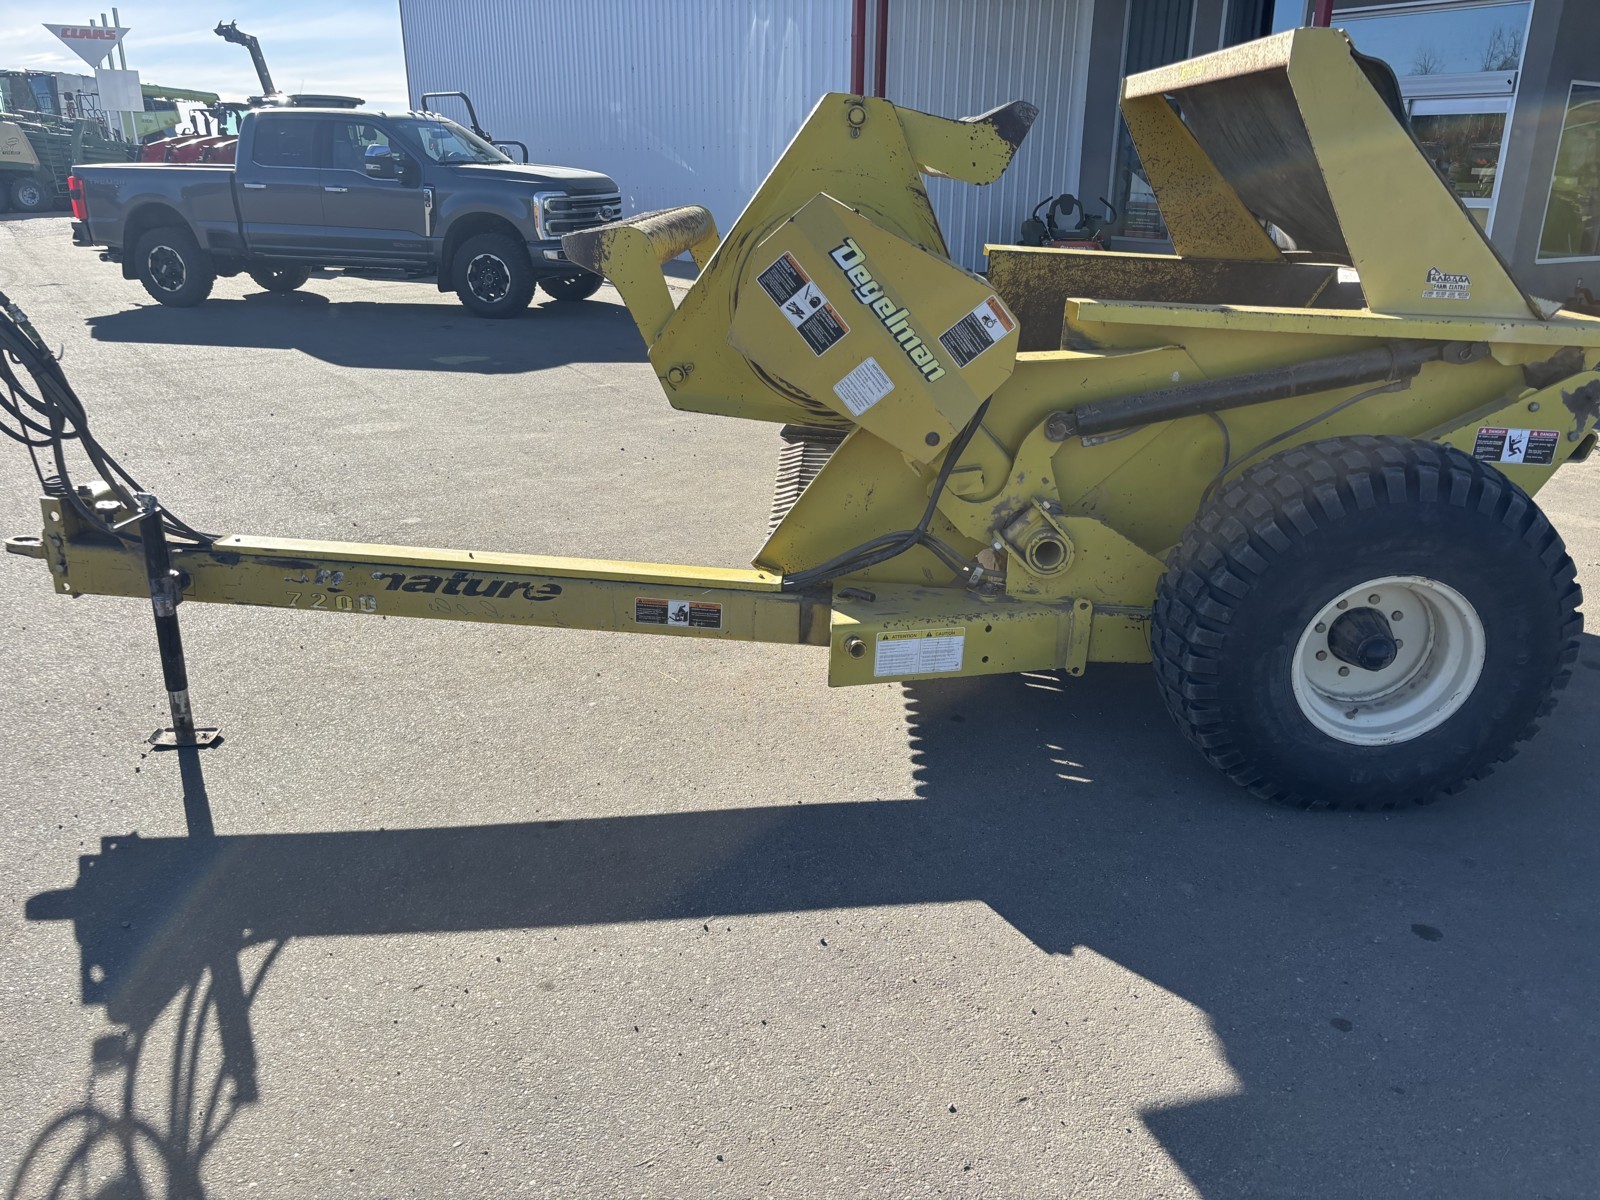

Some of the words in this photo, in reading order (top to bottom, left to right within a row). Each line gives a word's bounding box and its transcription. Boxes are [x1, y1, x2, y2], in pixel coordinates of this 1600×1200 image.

[61, 27, 116, 40] CLAAS
[1426, 267, 1470, 284] Pentagon
[828, 236, 946, 383] Degelman
[285, 591, 377, 613] 7200
